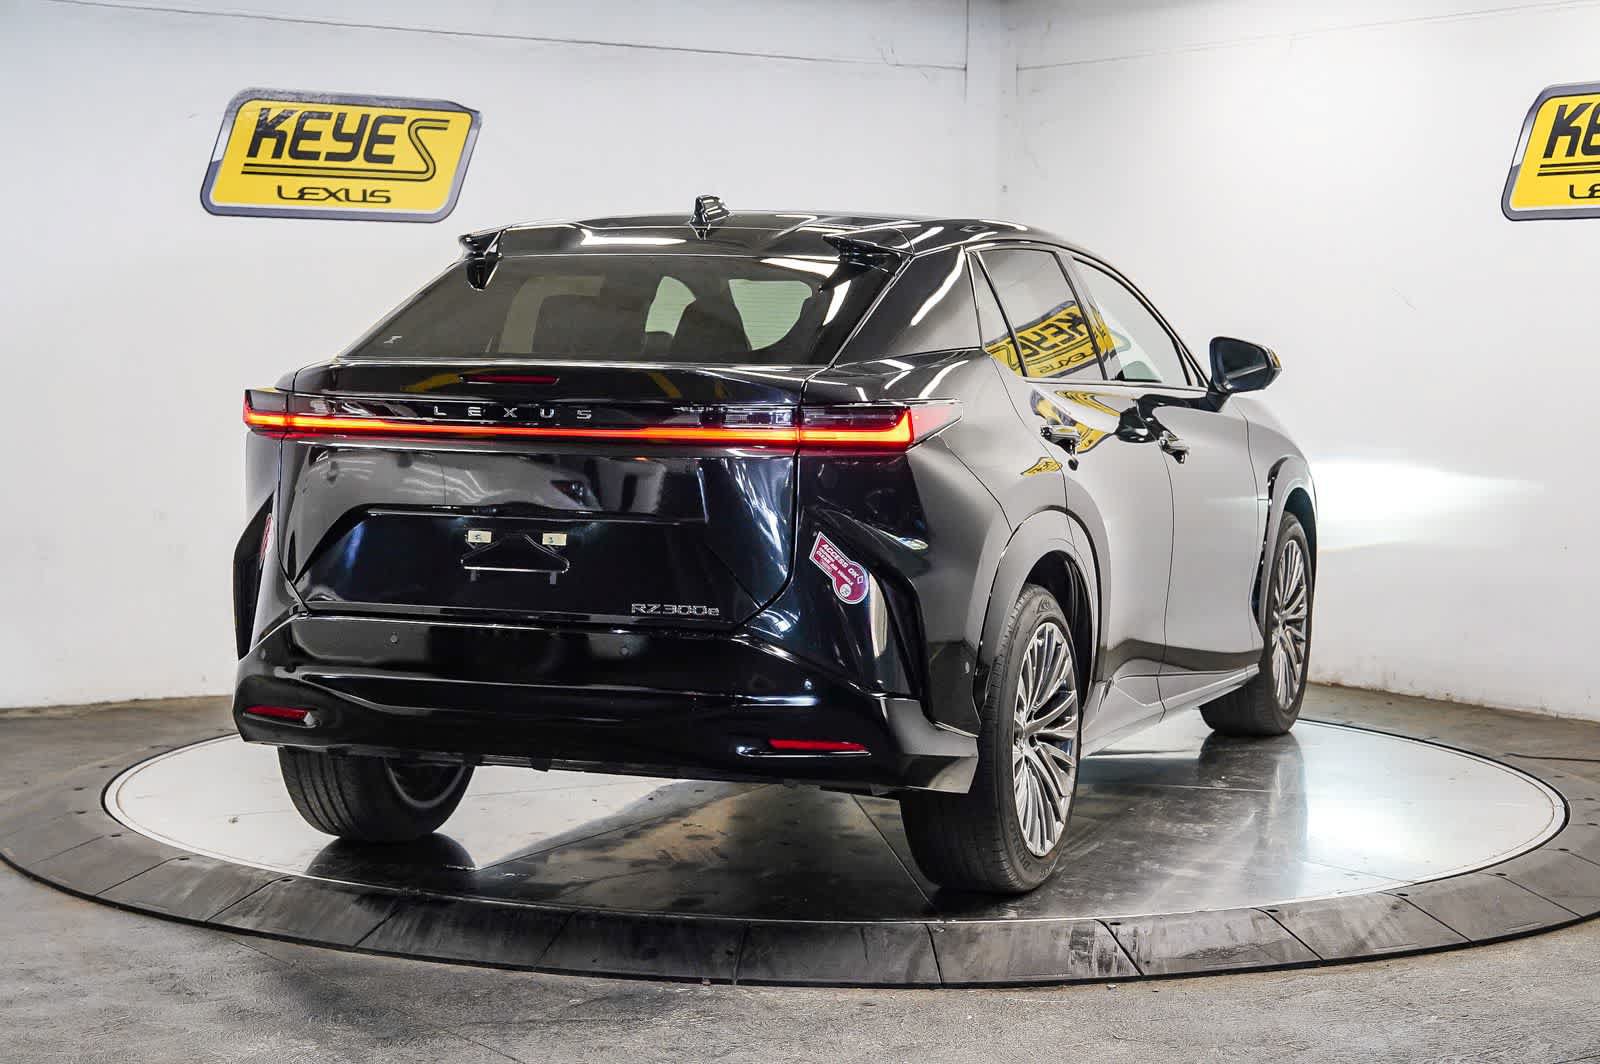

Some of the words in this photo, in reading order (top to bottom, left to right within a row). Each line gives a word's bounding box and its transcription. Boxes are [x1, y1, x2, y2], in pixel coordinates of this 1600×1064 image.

[246, 107, 451, 182] KEYES
[277, 185, 391, 203] LEXUS
[433, 405, 592, 420] LEXUS
[821, 544, 849, 568] ACCESS
